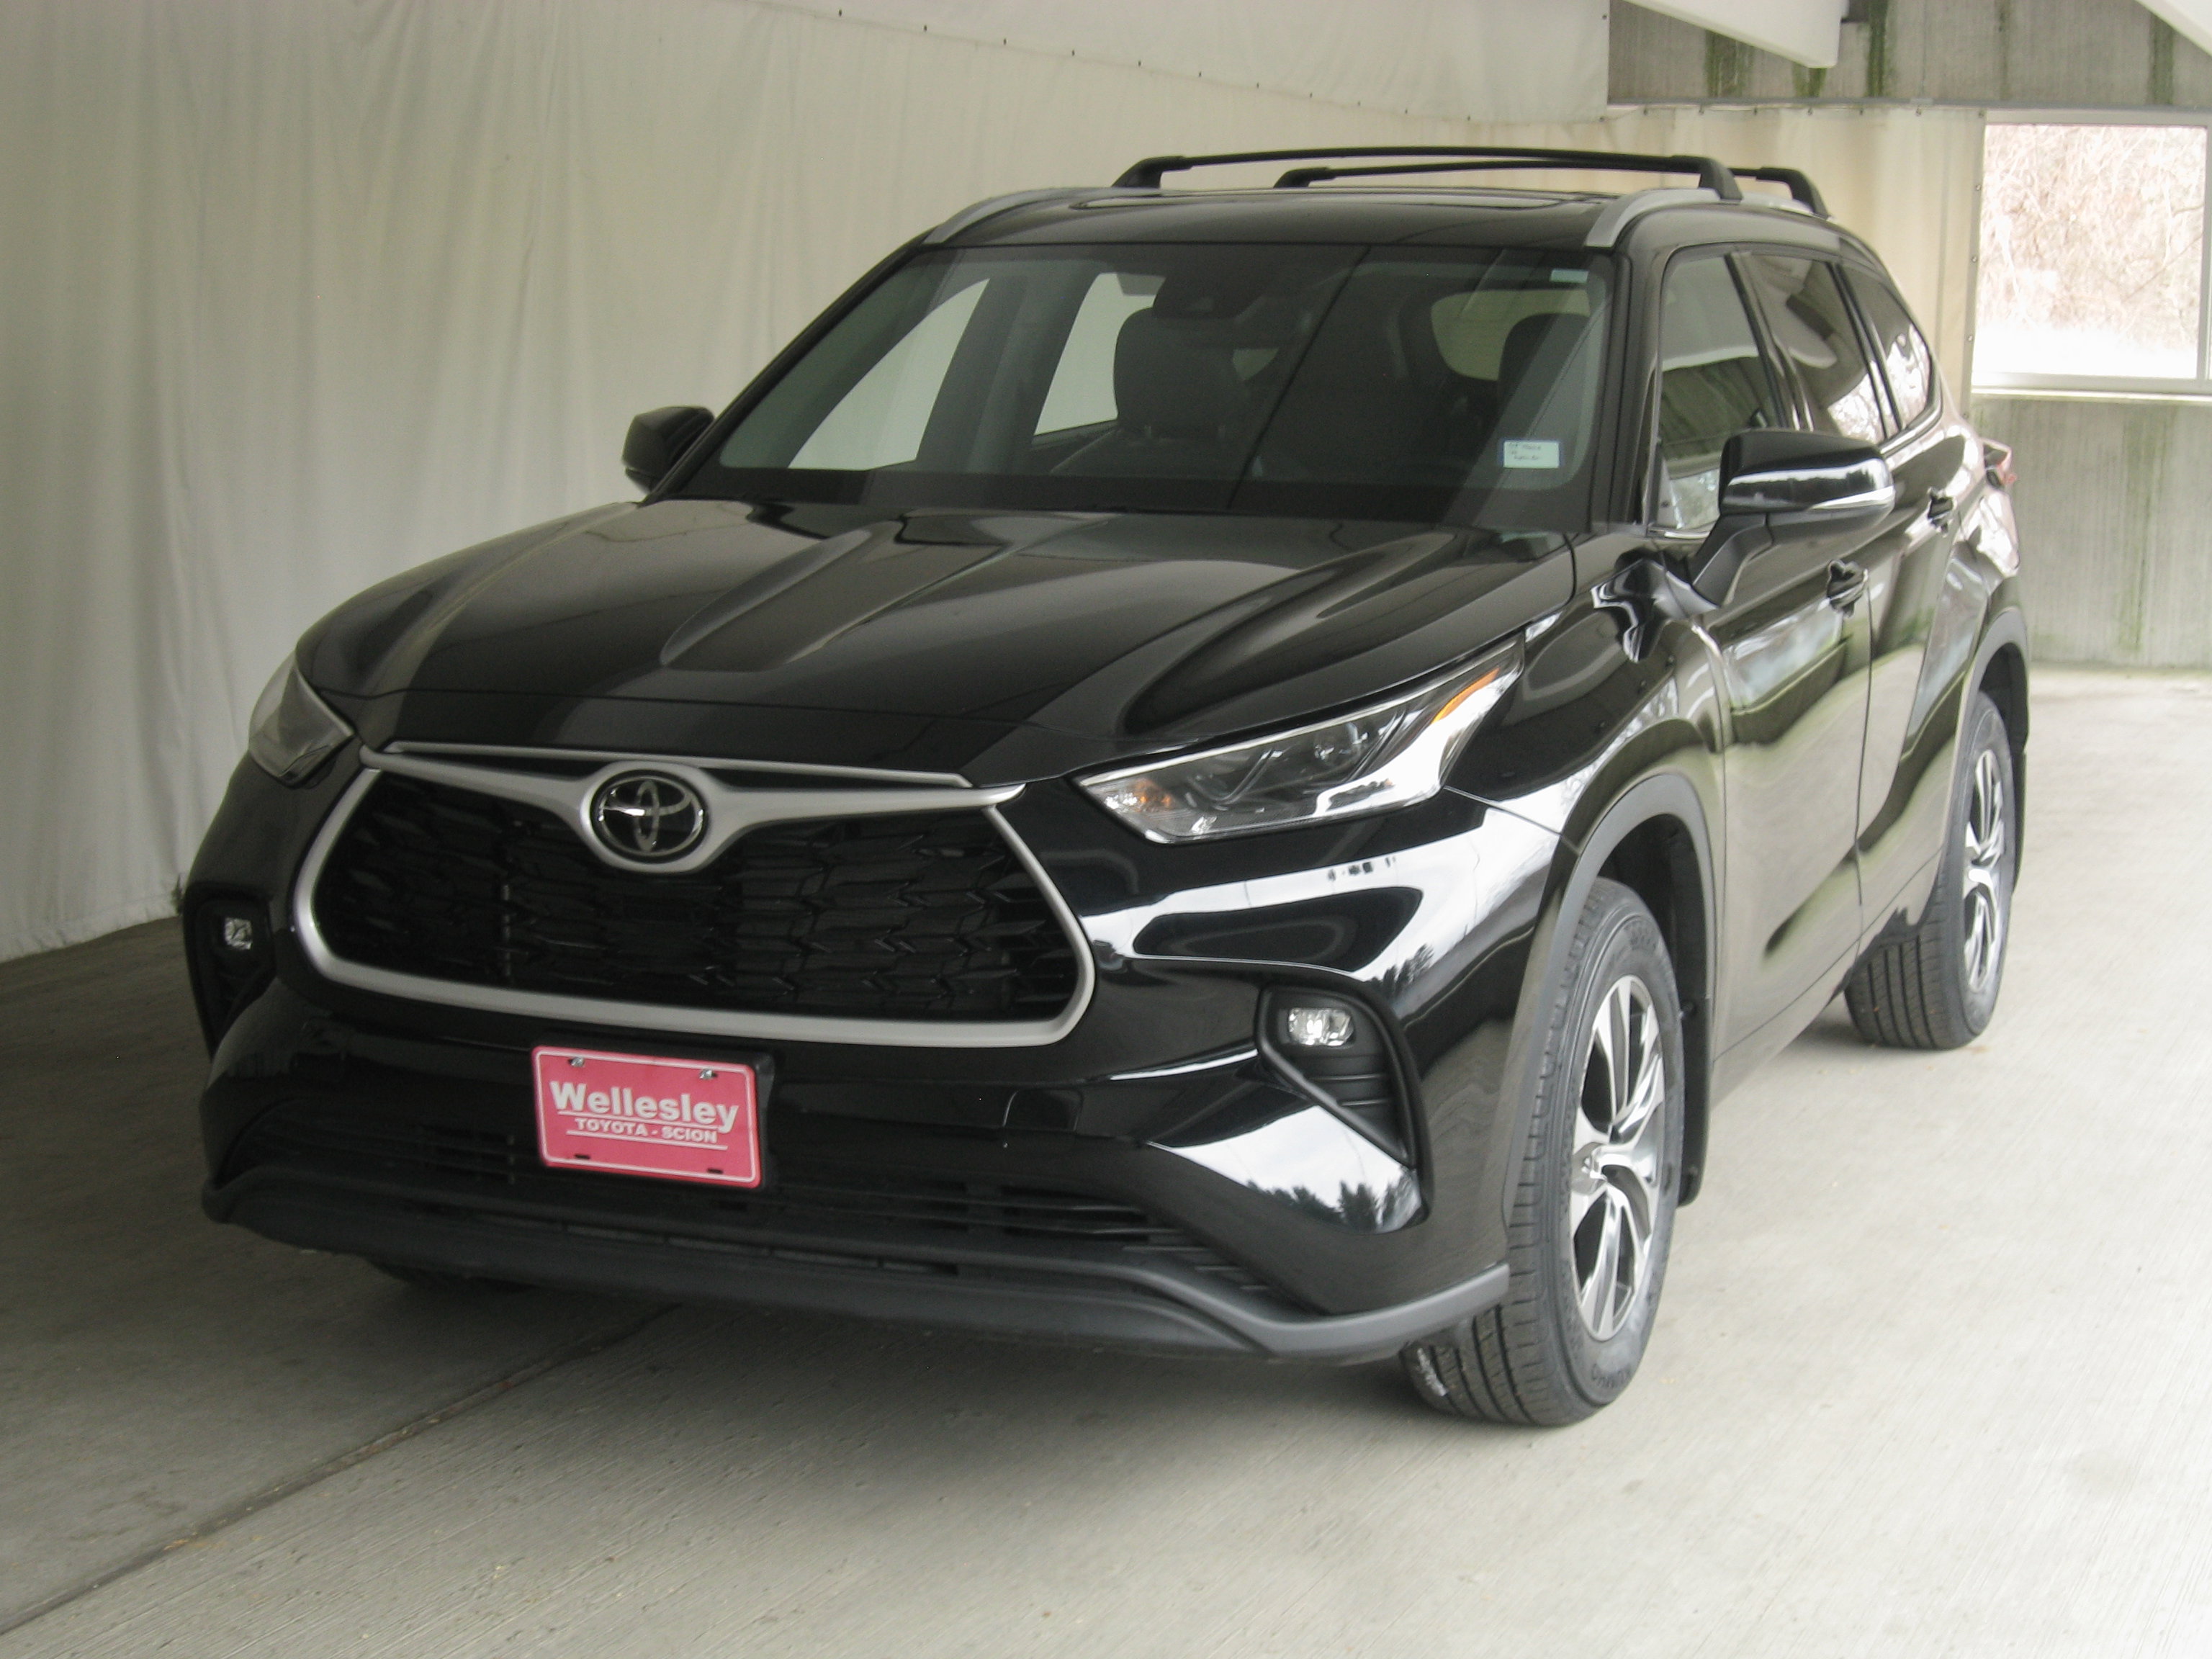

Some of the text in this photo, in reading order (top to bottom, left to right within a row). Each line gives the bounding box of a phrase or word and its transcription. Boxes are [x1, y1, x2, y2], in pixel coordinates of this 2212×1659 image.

[549, 1081, 739, 1134] Wellesley
[575, 1118, 648, 1137] TOYOTA
[662, 1126, 717, 1143] SCION
